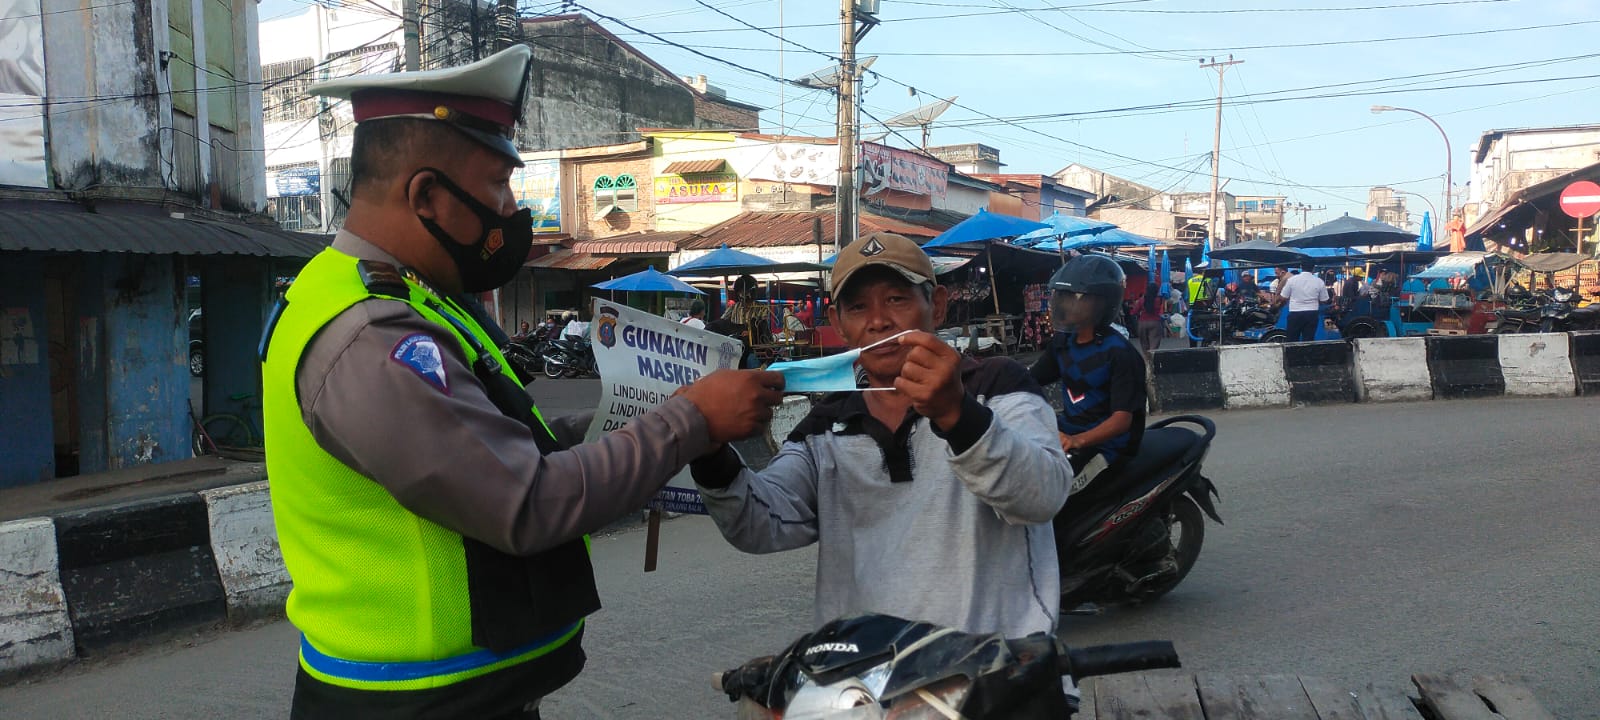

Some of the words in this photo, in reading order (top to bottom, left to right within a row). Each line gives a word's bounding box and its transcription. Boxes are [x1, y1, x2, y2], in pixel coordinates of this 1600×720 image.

[669, 184, 721, 198] ASUKA
[622, 324, 708, 366] GUNAKAN
[613, 383, 658, 405] LINDUNGI
[609, 401, 649, 418] LINDUN
[677, 492, 694, 503] TOBA
[805, 643, 859, 656] HONDA
